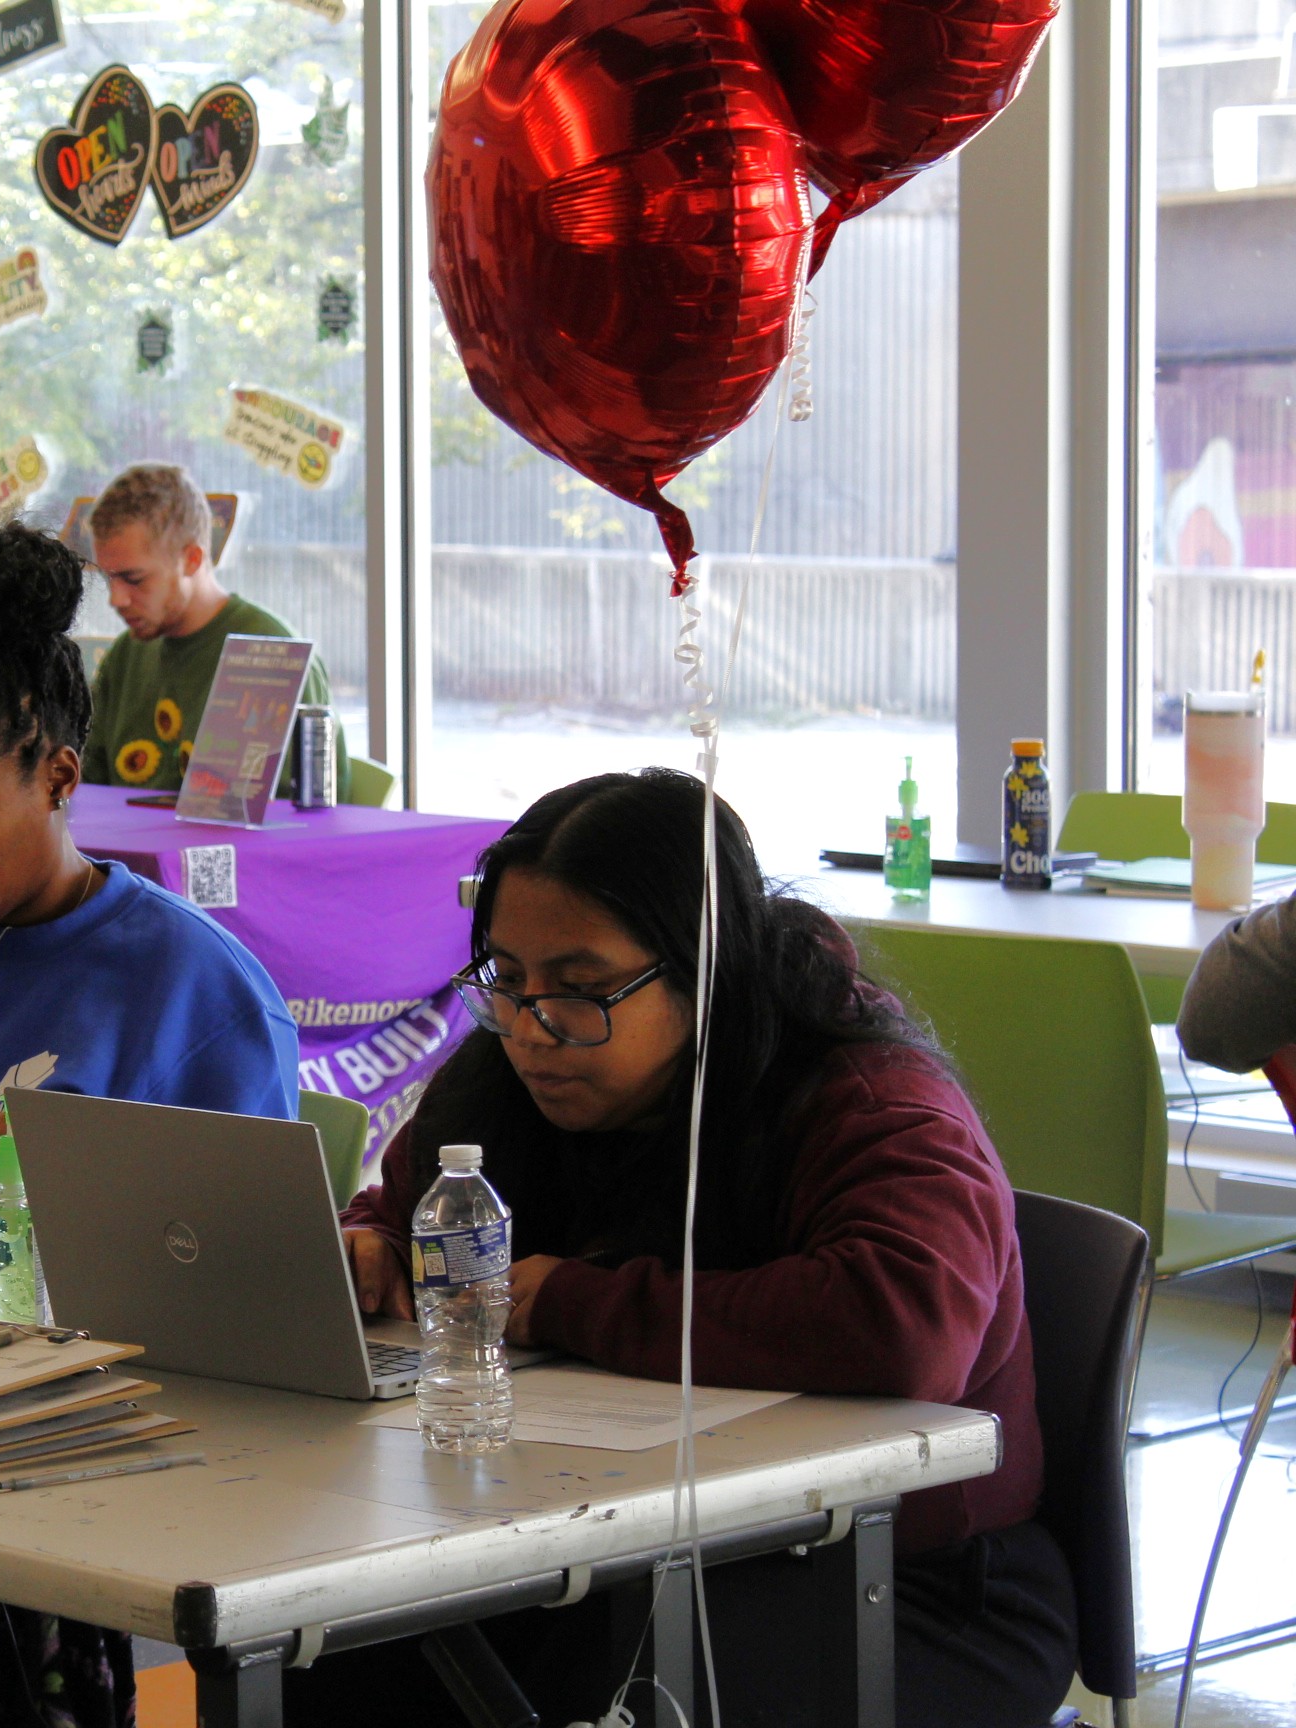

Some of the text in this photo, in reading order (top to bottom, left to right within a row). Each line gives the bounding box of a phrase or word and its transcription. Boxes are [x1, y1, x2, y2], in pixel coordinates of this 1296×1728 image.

[56, 110, 127, 191] OPEN
[76, 143, 145, 221] hearts
[160, 120, 221, 183] OPEN
[333, 998, 449, 1095] BUILT
[168, 1235, 195, 1249] DELL
